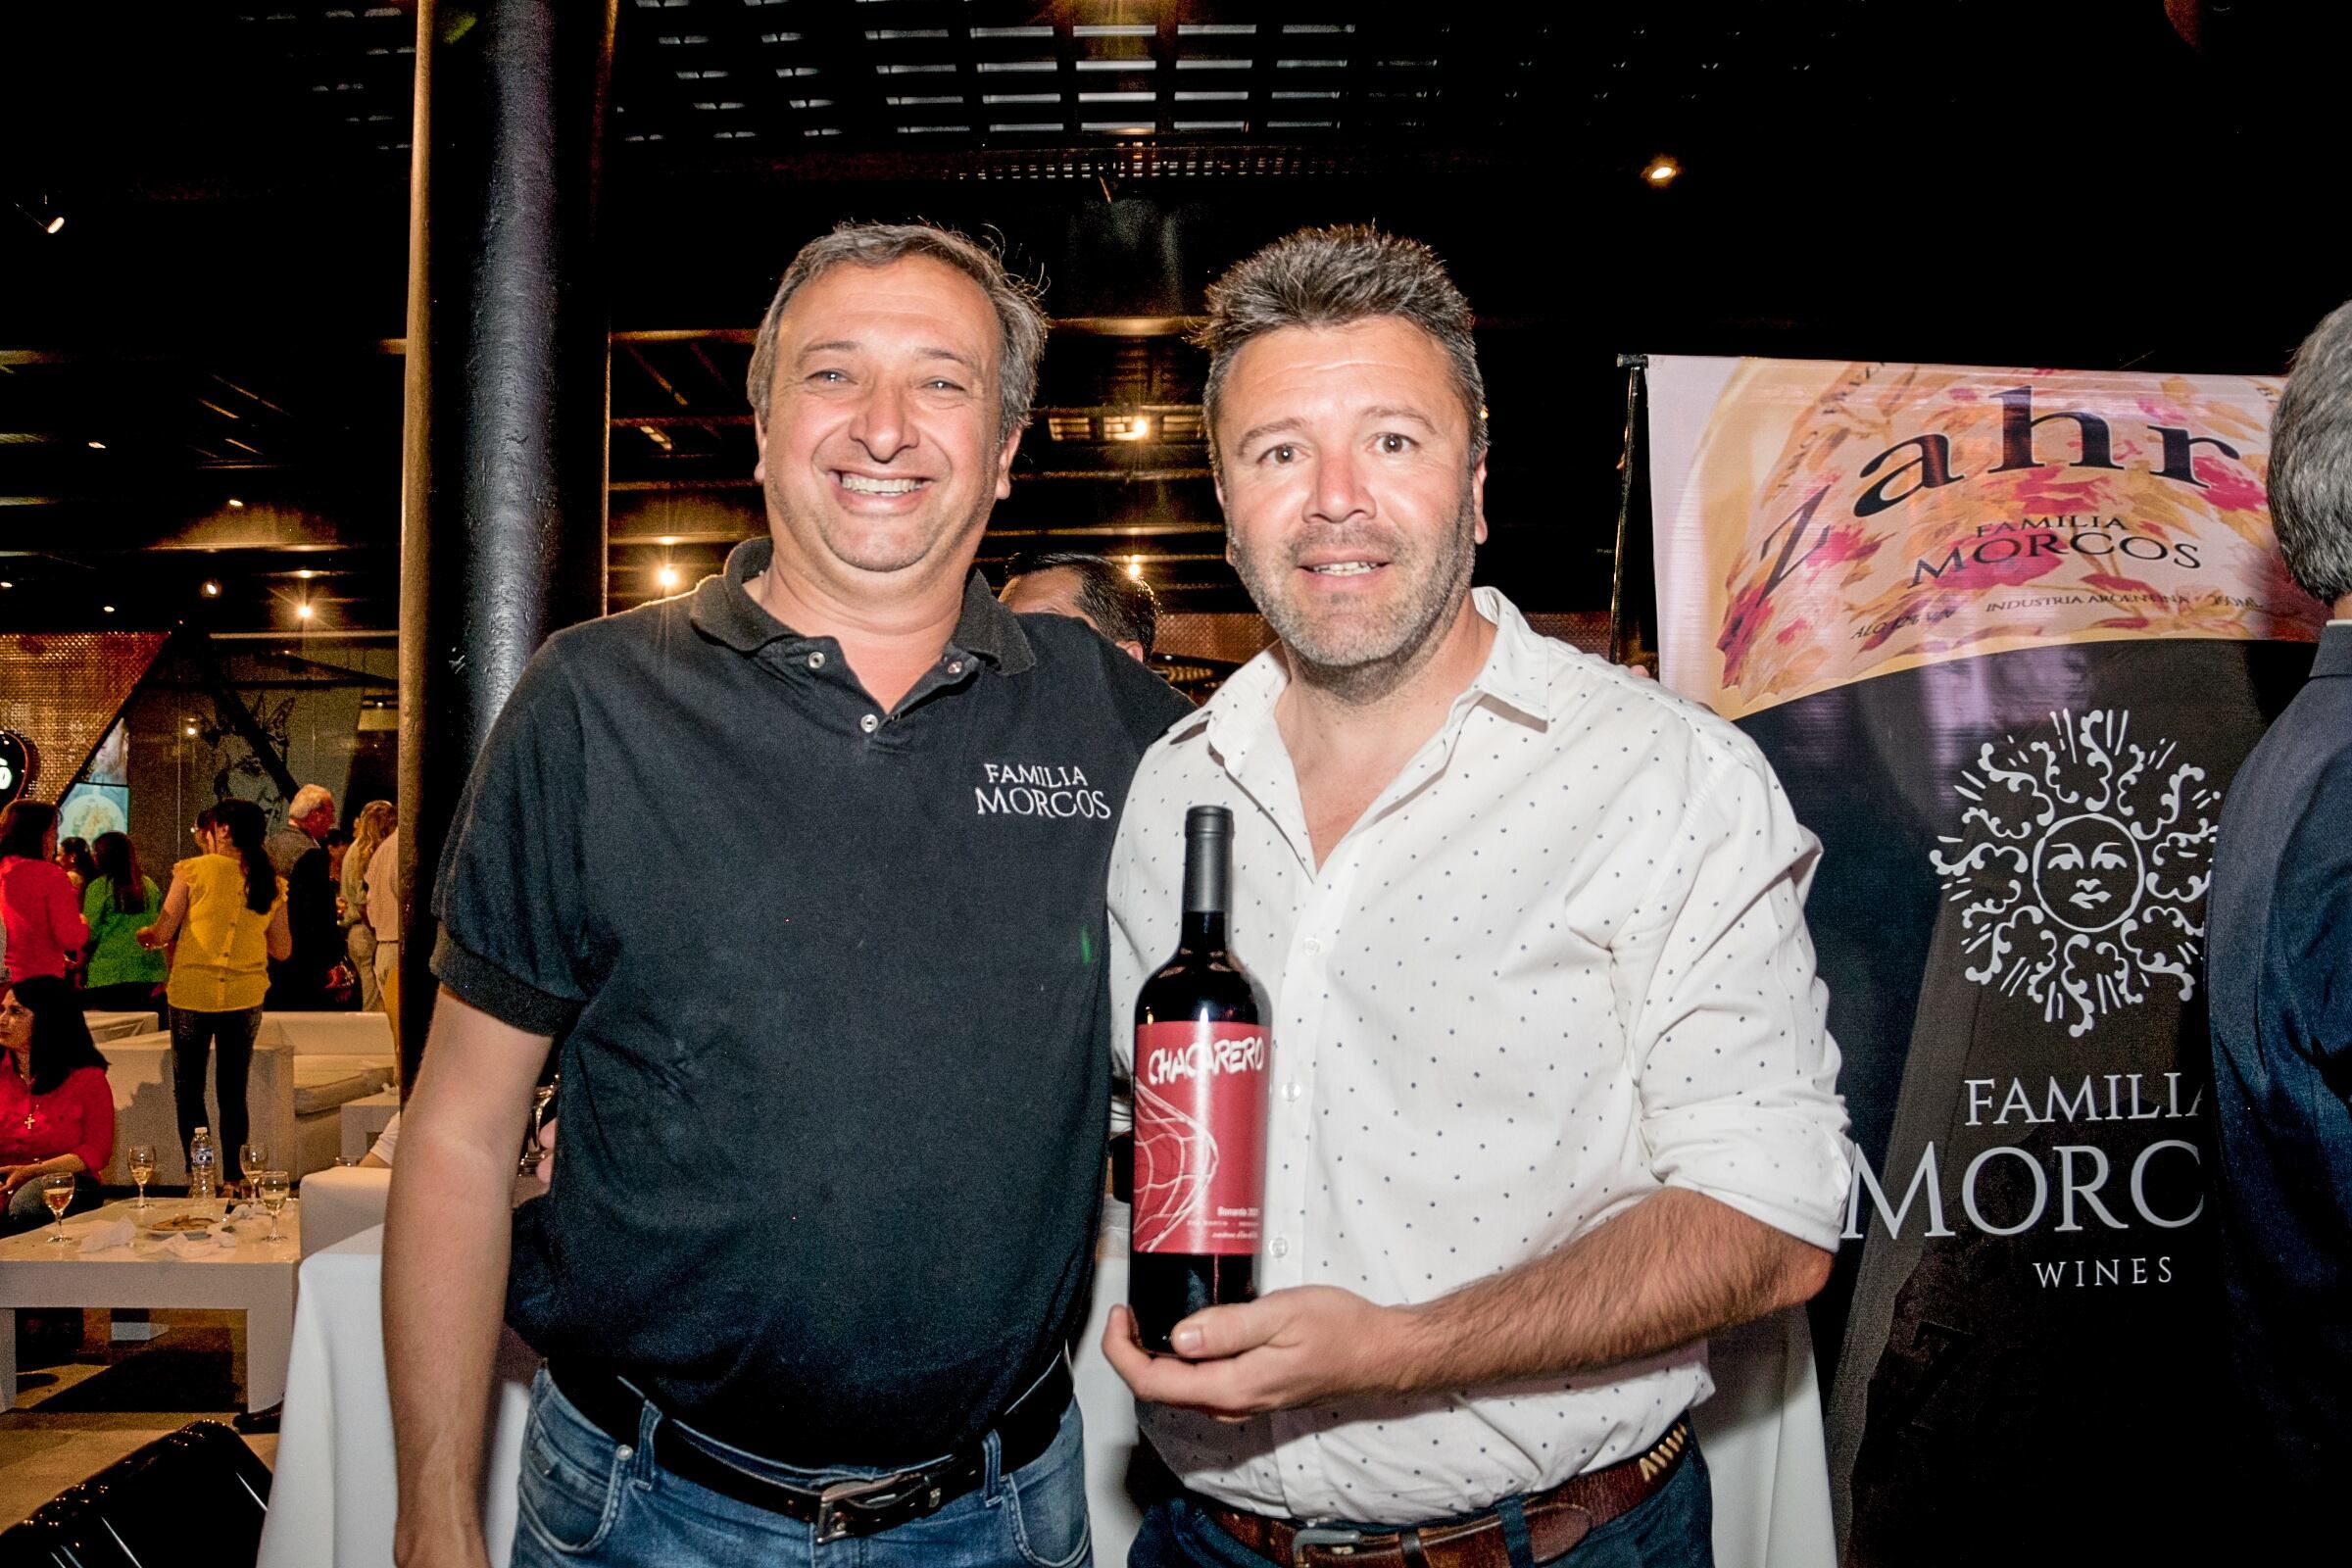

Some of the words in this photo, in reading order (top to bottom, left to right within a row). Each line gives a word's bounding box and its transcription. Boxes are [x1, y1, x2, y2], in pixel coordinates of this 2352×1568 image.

[1977, 514, 2128, 538] FAMILIA
[1907, 532, 2201, 588] MORCOS
[1986, 596, 2083, 612] INDUSTRIA
[984, 763, 1089, 788] FAMILIA
[975, 786, 1111, 819] MORCOS
[1841, 1139, 2205, 1240] MORC
[2033, 1255, 2173, 1289] WINES
